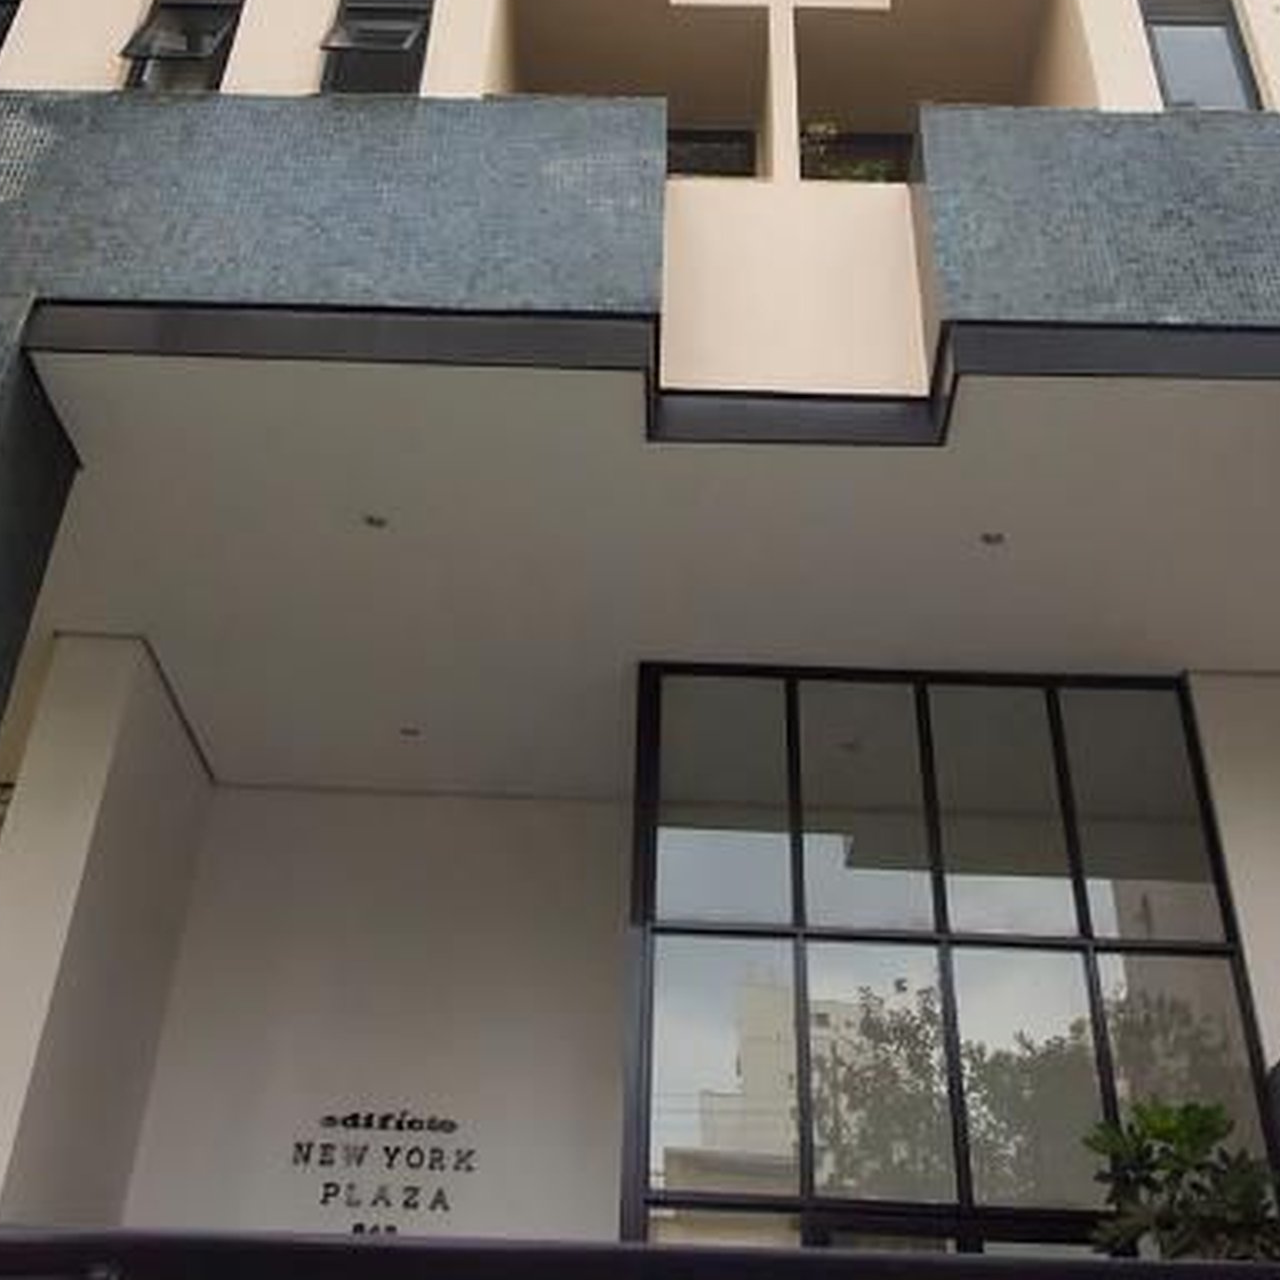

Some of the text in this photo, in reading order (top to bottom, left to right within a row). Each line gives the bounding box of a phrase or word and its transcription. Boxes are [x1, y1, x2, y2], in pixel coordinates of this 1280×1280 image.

[292, 1142, 477, 1173] NEW YORK
[320, 1182, 451, 1212] PLAZA
